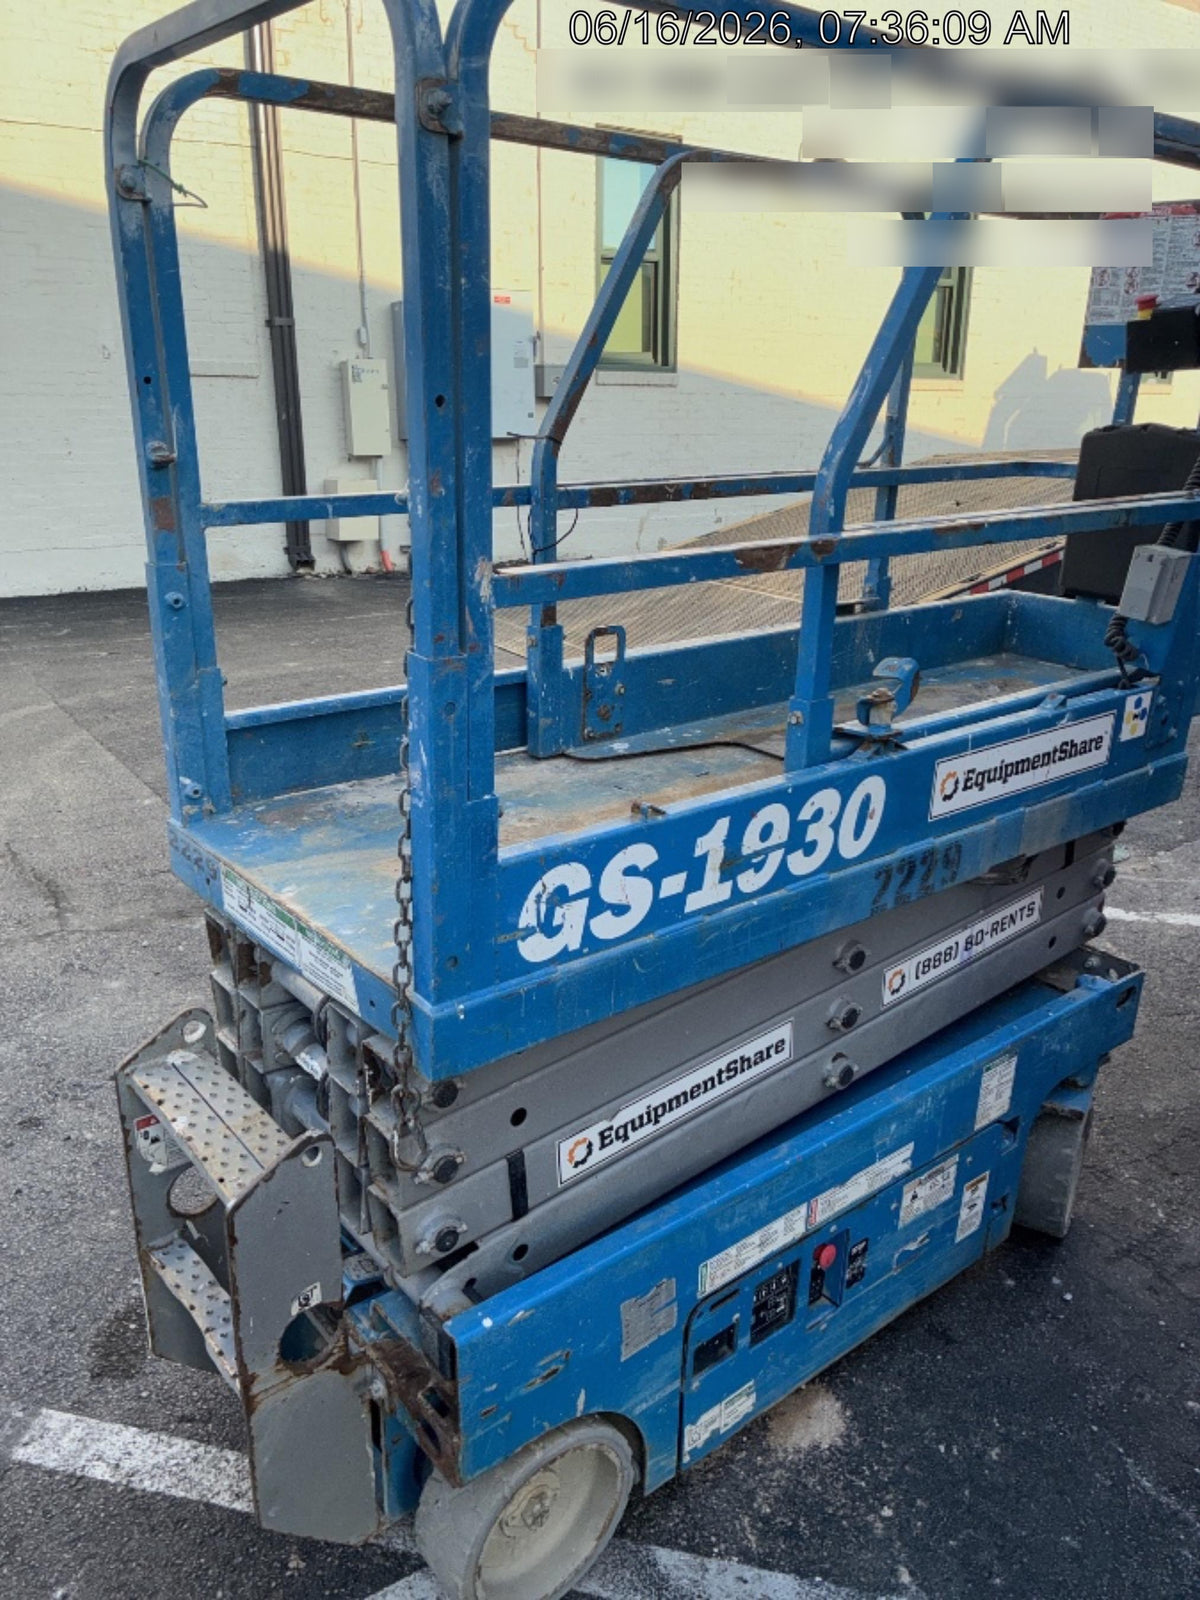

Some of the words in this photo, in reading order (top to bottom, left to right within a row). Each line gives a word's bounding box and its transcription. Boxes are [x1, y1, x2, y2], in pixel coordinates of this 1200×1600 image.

[962, 734, 1104, 792] EquipmentShare
[517, 775, 887, 963] GS-1930
[914, 942, 960, 980] (888)
[963, 901, 1036, 952] 80-RENTS
[598, 1038, 786, 1151] EquipmentShare
